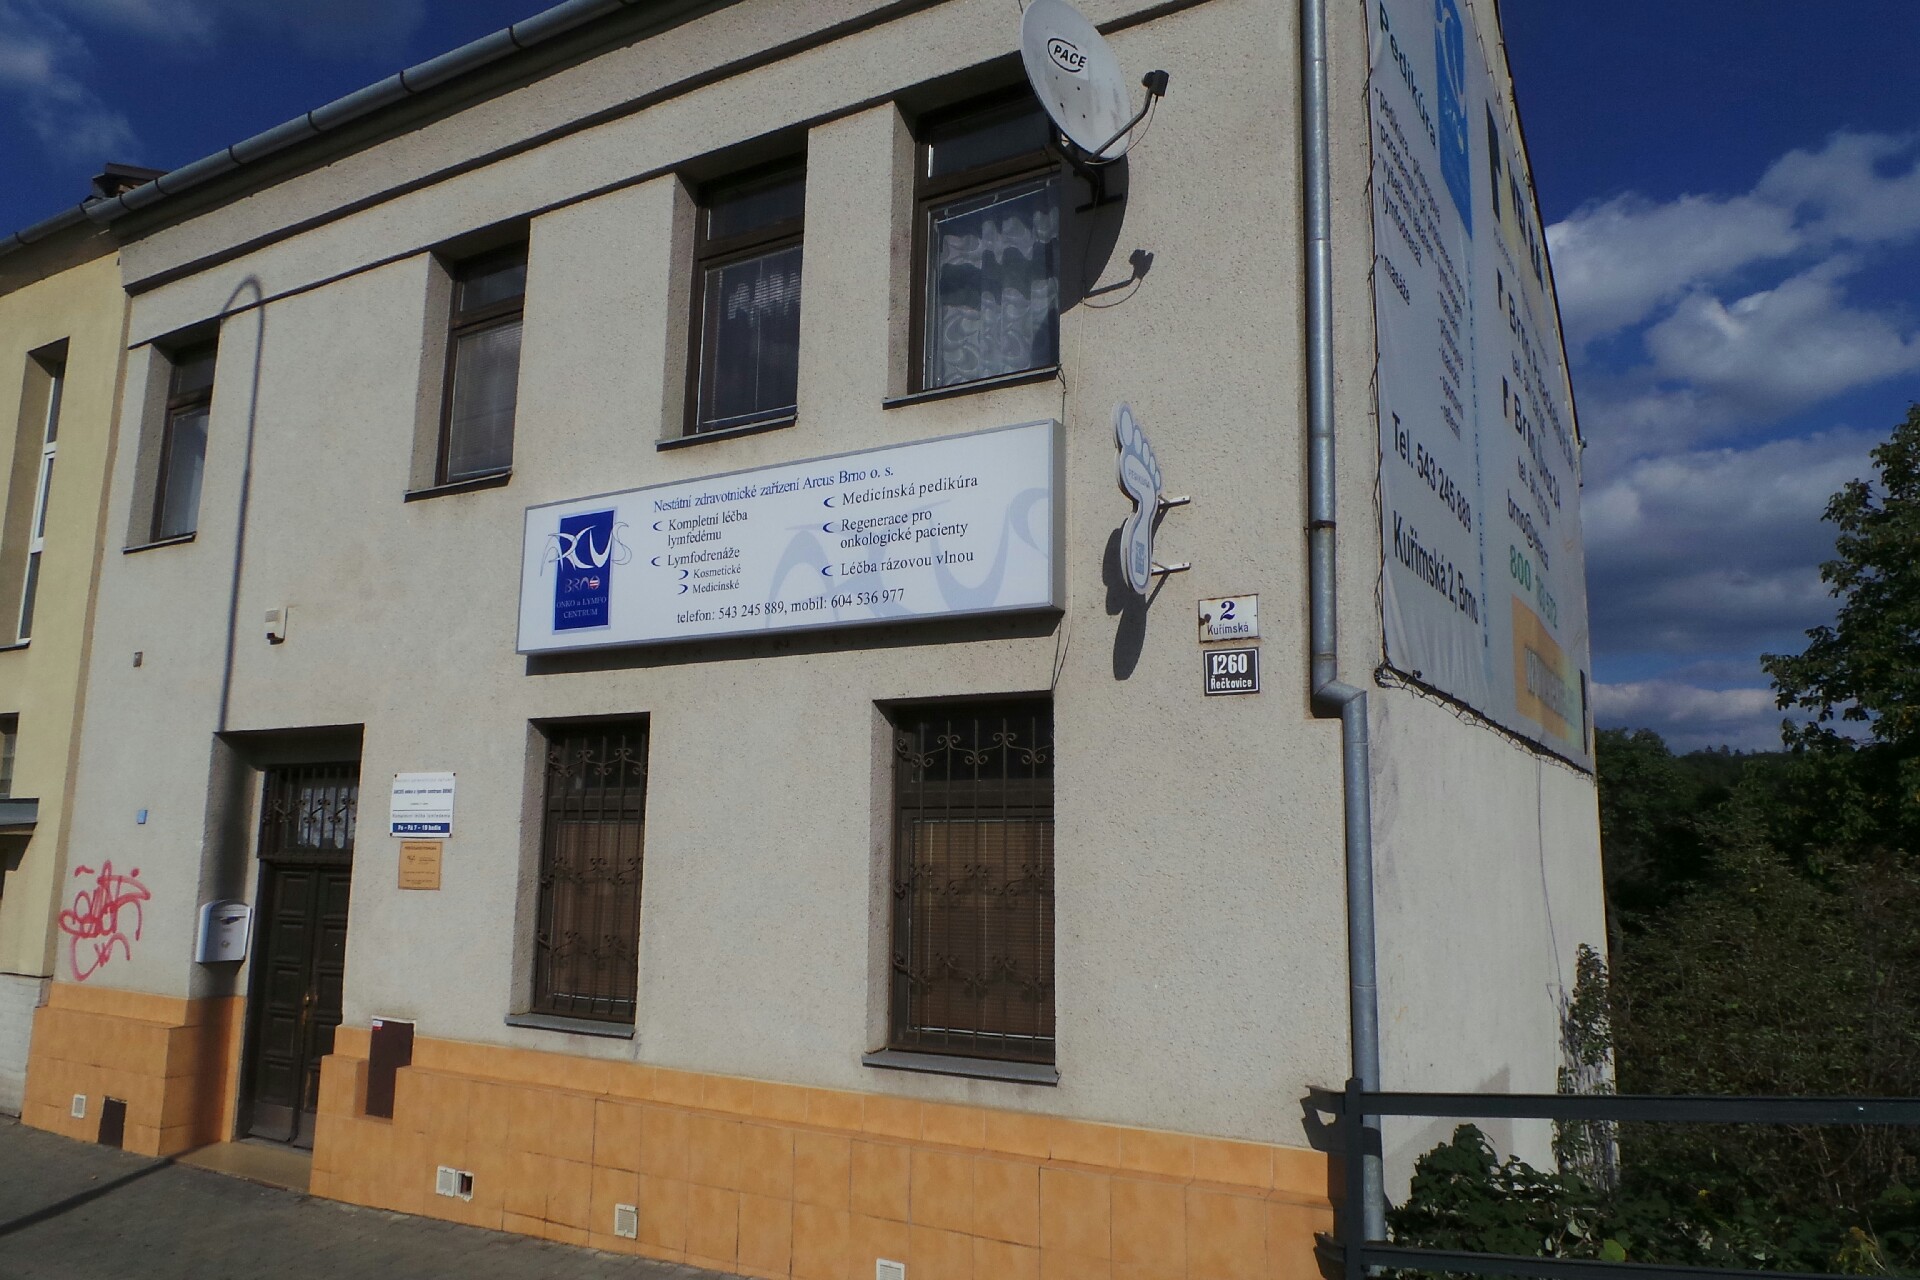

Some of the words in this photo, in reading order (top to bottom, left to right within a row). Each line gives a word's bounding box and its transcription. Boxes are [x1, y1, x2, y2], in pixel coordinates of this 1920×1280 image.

[1053, 44, 1087, 68] PACE
[1379, 0, 1436, 150] Pedikúra
[1392, 409, 1414, 469] Tel.
[1417, 442, 1436, 492] 543
[1438, 467, 1456, 514] 245
[653, 497, 692, 514] Nestátní
[694, 487, 757, 507] zdravotnické
[760, 479, 800, 497] zařízení
[803, 475, 835, 490] Arcus
[839, 469, 867, 484] Brno
[870, 468, 881, 479] o.
[884, 466, 894, 477] s.
[842, 481, 916, 506] Medicínská
[919, 474, 979, 499] pedikúra
[668, 512, 719, 532] Kompletní
[722, 509, 748, 525] léčba
[841, 512, 909, 534] Regenerace
[912, 508, 933, 525] pro
[667, 529, 722, 550] lymfedému
[840, 527, 912, 550] onkologické
[915, 521, 969, 545] pacienty
[667, 547, 741, 570] Lymfodrenáže
[693, 563, 742, 579] Kosmetické
[841, 559, 878, 577] Léčba
[880, 554, 933, 572] rázovou
[936, 550, 975, 566] vlnou
[1393, 510, 1447, 598] Kuřimská
[1457, 570, 1479, 625] Brno
[1509, 544, 1531, 592] 800
[563, 608, 598, 619] CENTRUM
[676, 609, 716, 625] telefon:
[718, 605, 738, 621] 543
[741, 603, 761, 618] 245
[764, 600, 788, 616] 889,
[790, 596, 827, 613] mobil:
[830, 594, 853, 610] 604
[856, 591, 879, 607] 536
[882, 588, 905, 604] 977
[1219, 600, 1236, 621] 2
[1207, 622, 1249, 636] Kuřimská
[1212, 653, 1248, 675] 1260
[1210, 675, 1252, 690] Řečkovice
